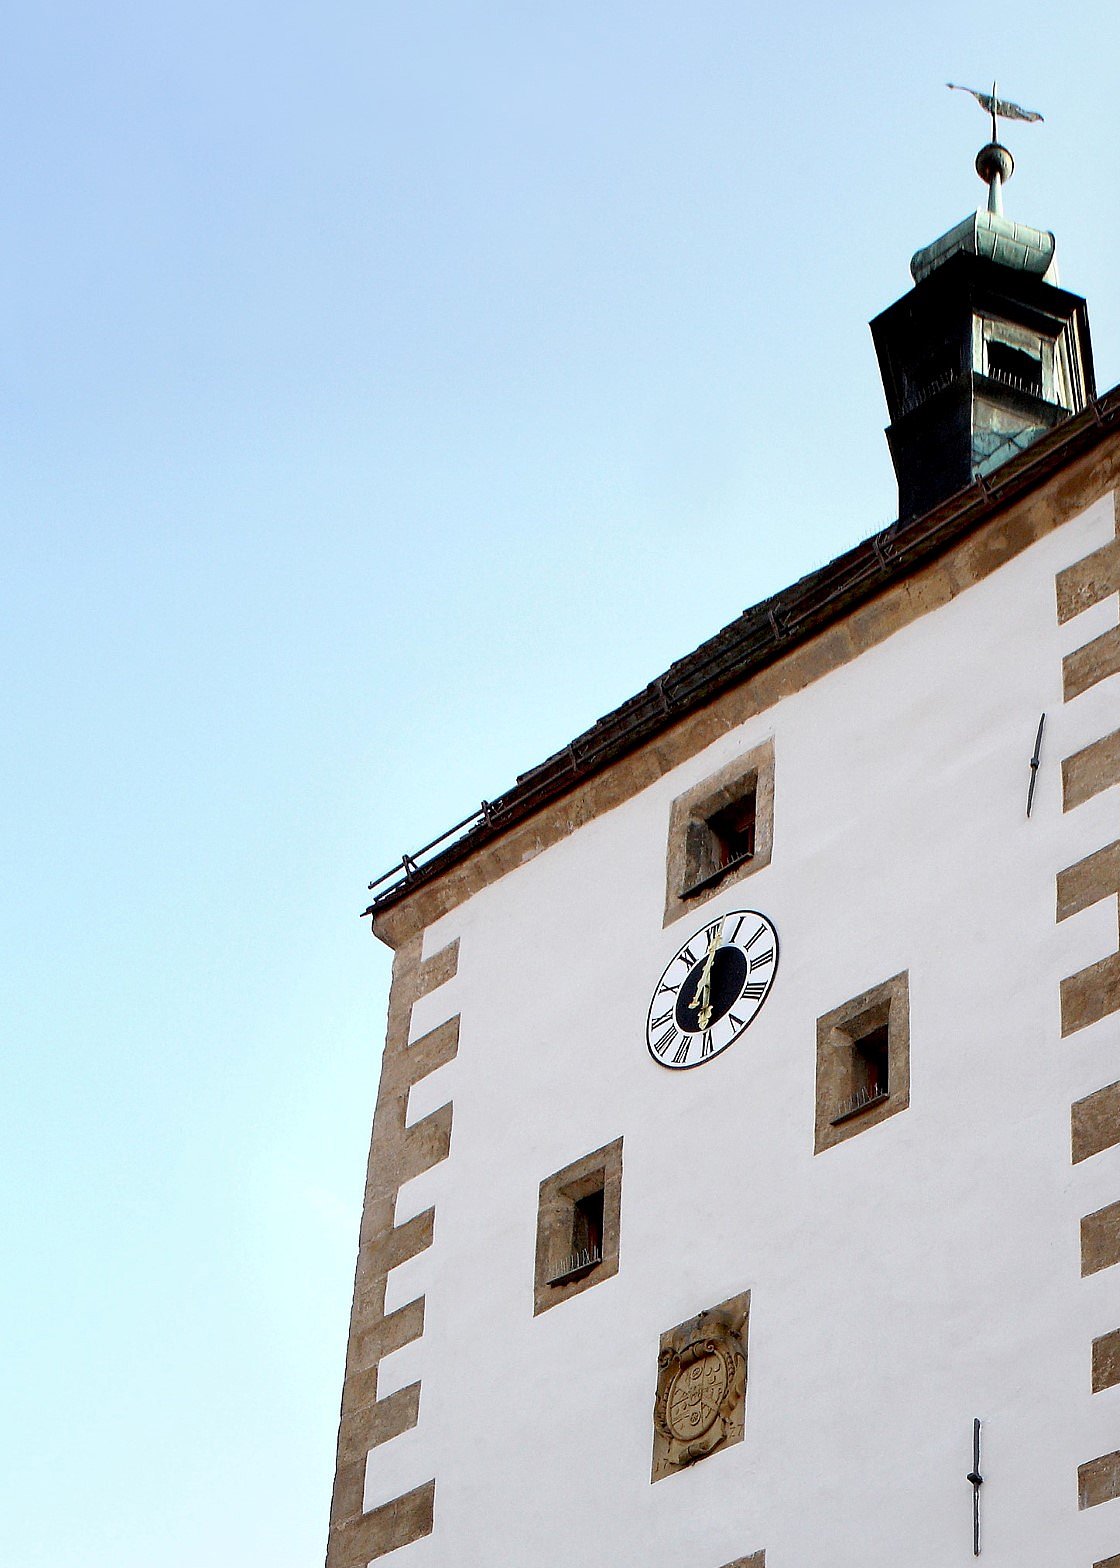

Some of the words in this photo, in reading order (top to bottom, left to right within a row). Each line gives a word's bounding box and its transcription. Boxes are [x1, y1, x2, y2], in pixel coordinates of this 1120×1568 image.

[728, 916, 746, 943] I
[743, 923, 768, 952] II
[677, 945, 699, 973] XI
[750, 946, 773, 974] III
[658, 982, 681, 996] X
[740, 980, 768, 1002] IIII
[651, 1006, 674, 1031] IX
[728, 1013, 746, 1034] V
[653, 1022, 679, 1057] VIII
[671, 1035, 693, 1063] VII
[700, 1028, 715, 1058] VI
